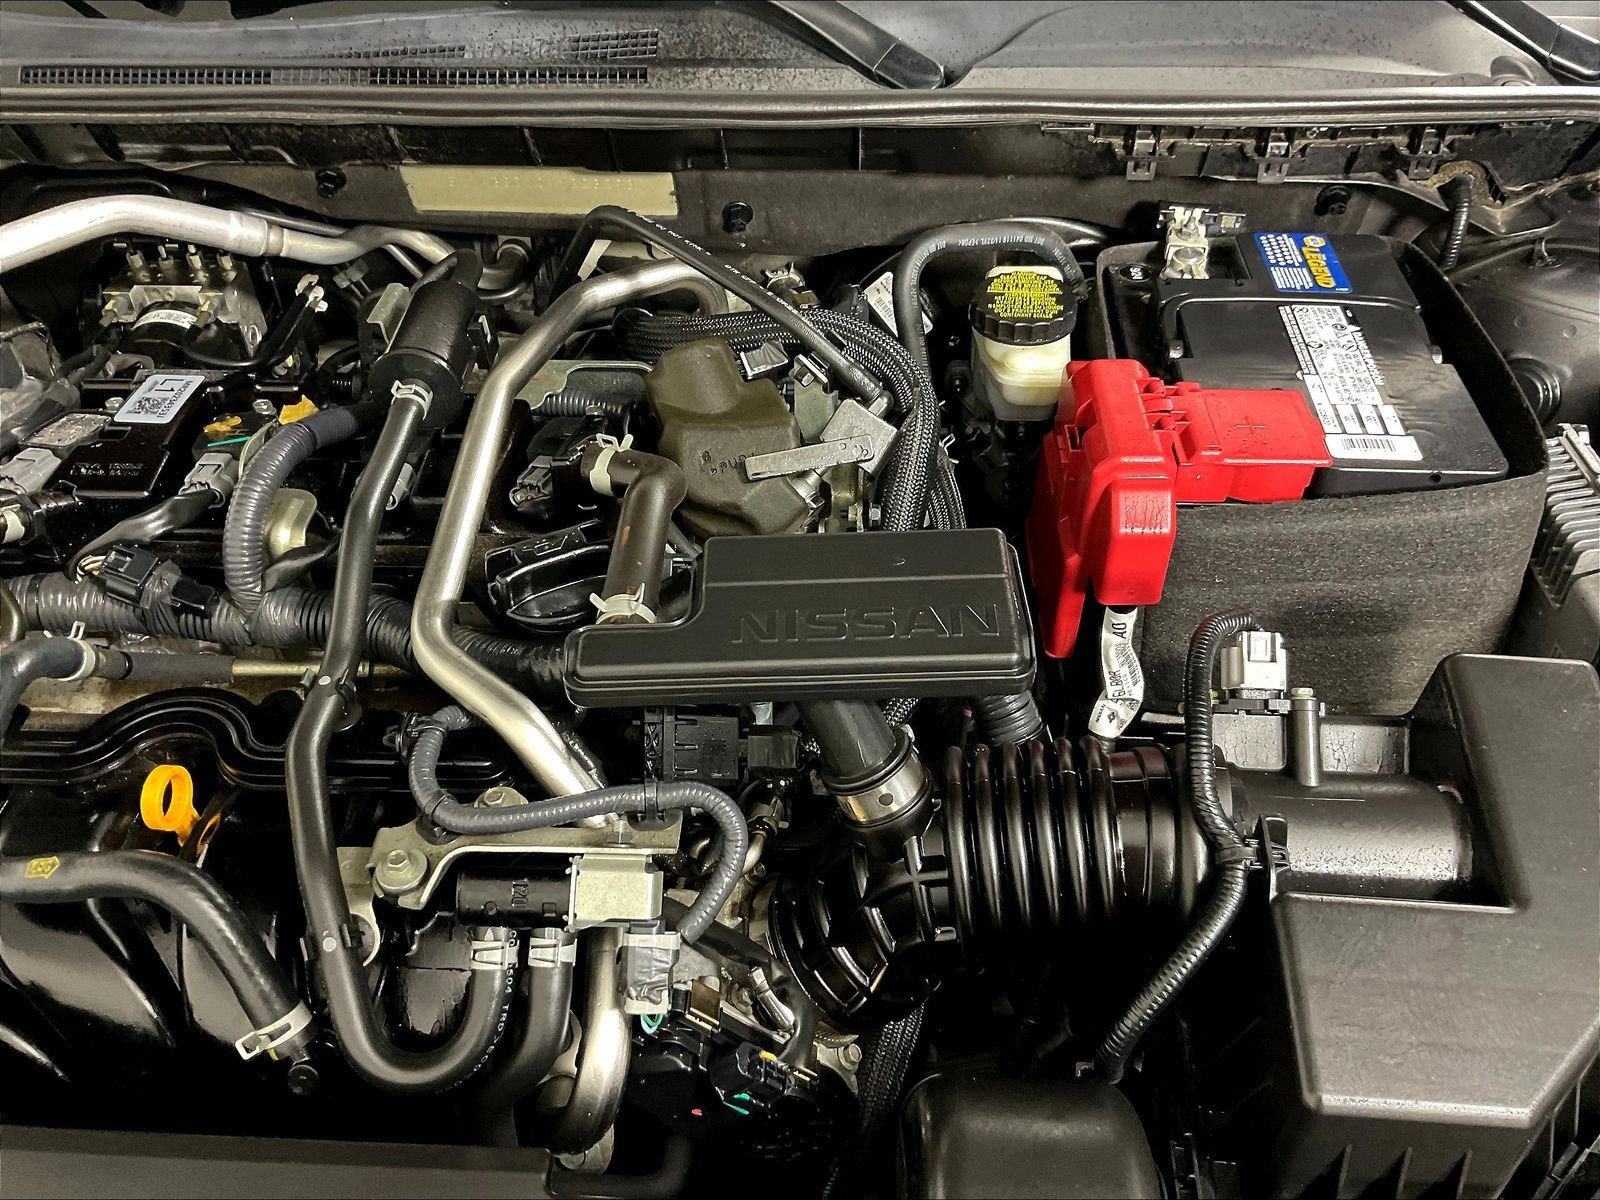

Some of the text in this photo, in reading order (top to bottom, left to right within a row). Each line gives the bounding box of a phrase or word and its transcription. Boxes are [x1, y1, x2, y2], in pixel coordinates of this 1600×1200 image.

[1301, 246, 1336, 288] LEGEND
[154, 378, 185, 392] L1
[730, 603, 1000, 644] NISSAN
[1095, 704, 1106, 723] NISSAN
